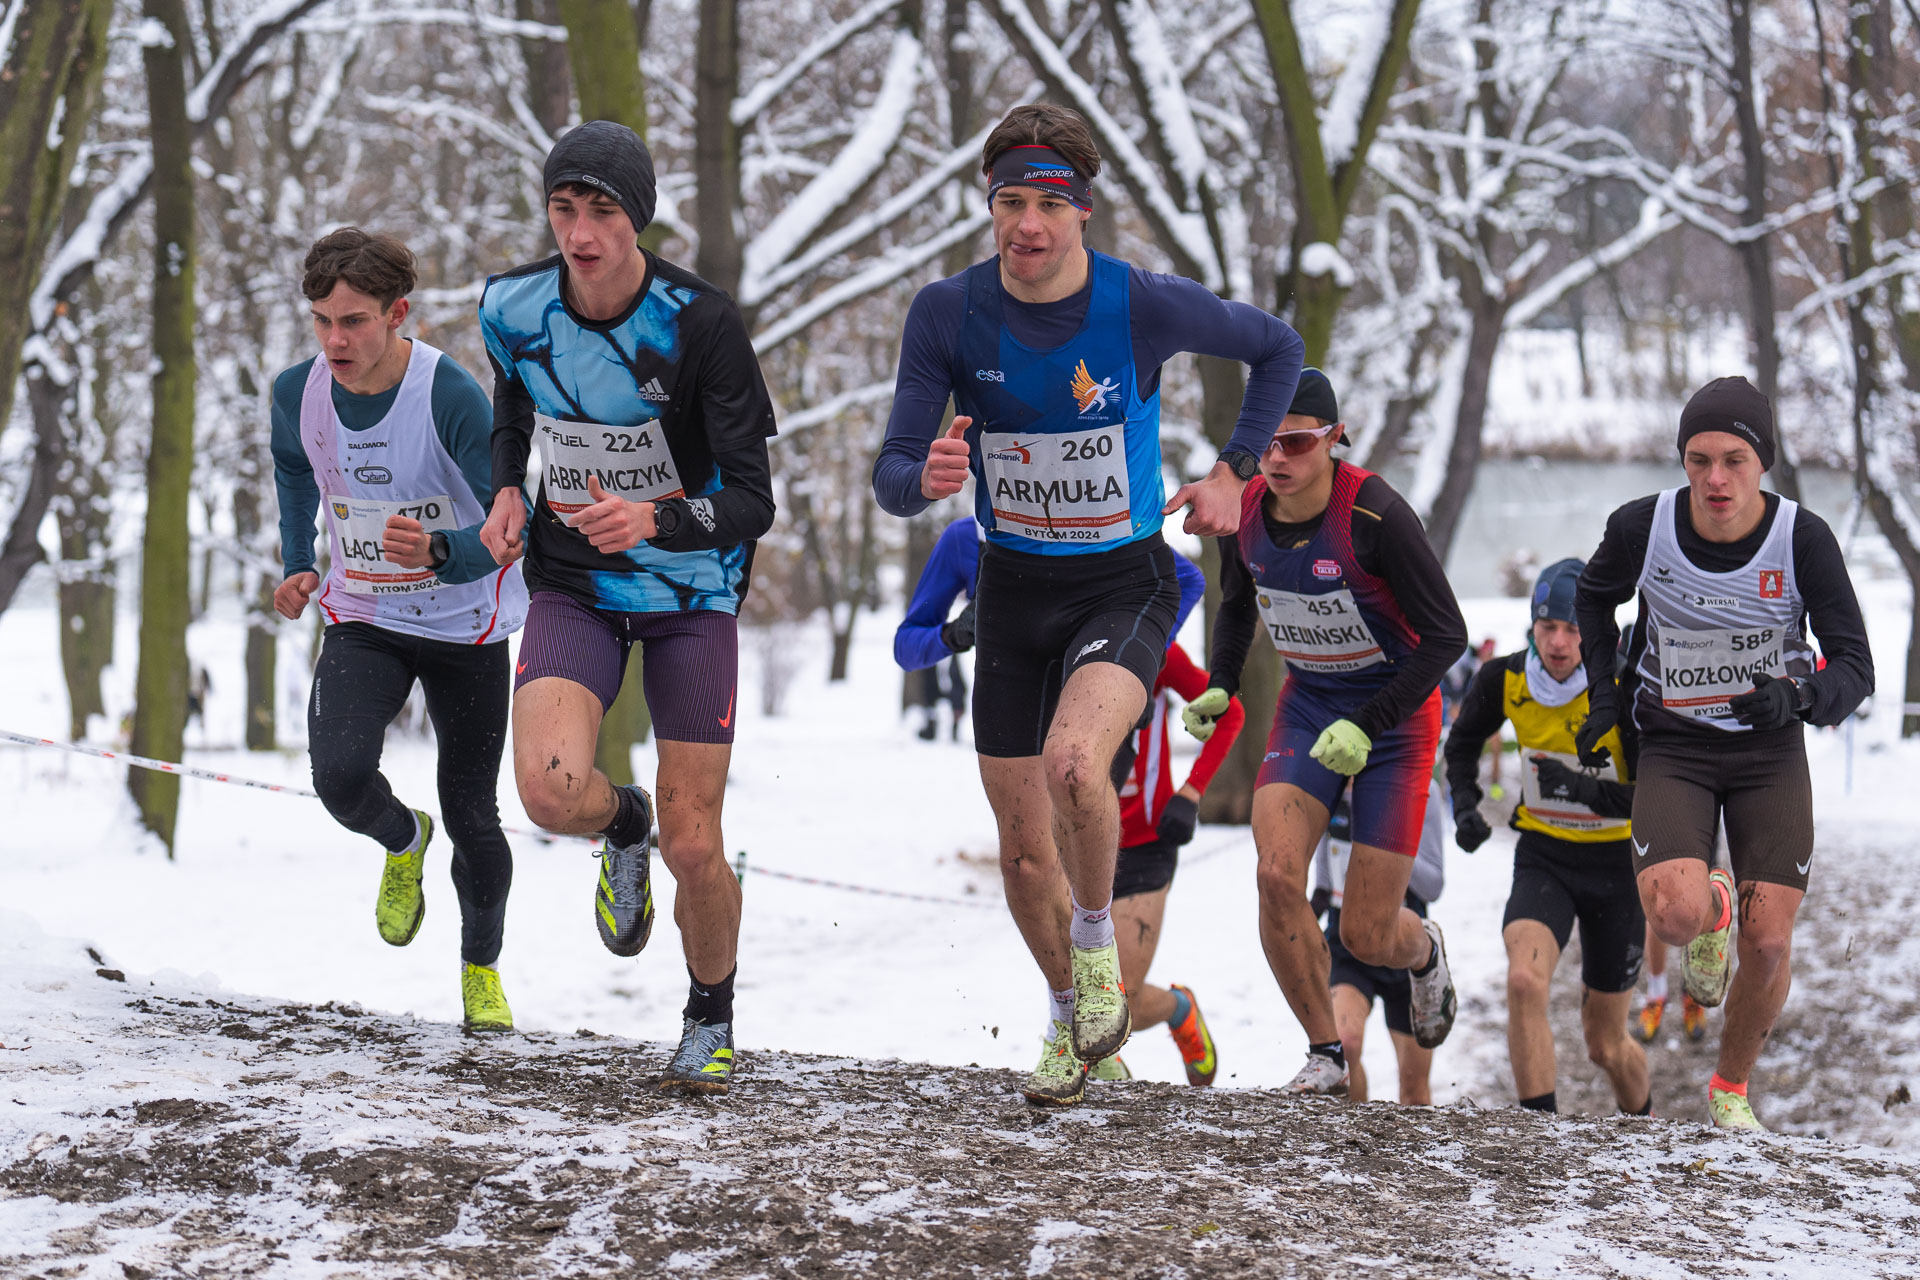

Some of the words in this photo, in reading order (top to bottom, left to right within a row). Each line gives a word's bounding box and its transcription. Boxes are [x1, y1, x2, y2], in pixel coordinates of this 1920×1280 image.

[1024, 170, 1074, 180] IMPRODEX
[635, 391, 670, 402] adidas
[347, 441, 388, 450] SALOMON
[553, 431, 590, 448] FUEL
[602, 430, 653, 453] 224
[1061, 435, 1113, 462] 260
[987, 452, 1021, 462] polanik
[995, 475, 1124, 504] ARMUŁA
[1024, 528, 1068, 540] BYTOM
[1069, 530, 1101, 540] 2024
[372, 585, 411, 594] BYTOM
[412, 578, 441, 591] 2024
[1307, 597, 1348, 616] 451
[1731, 629, 1774, 651] 588
[1303, 661, 1335, 671] BYTOM
[1665, 649, 1779, 688] KOZŁOWSKI
